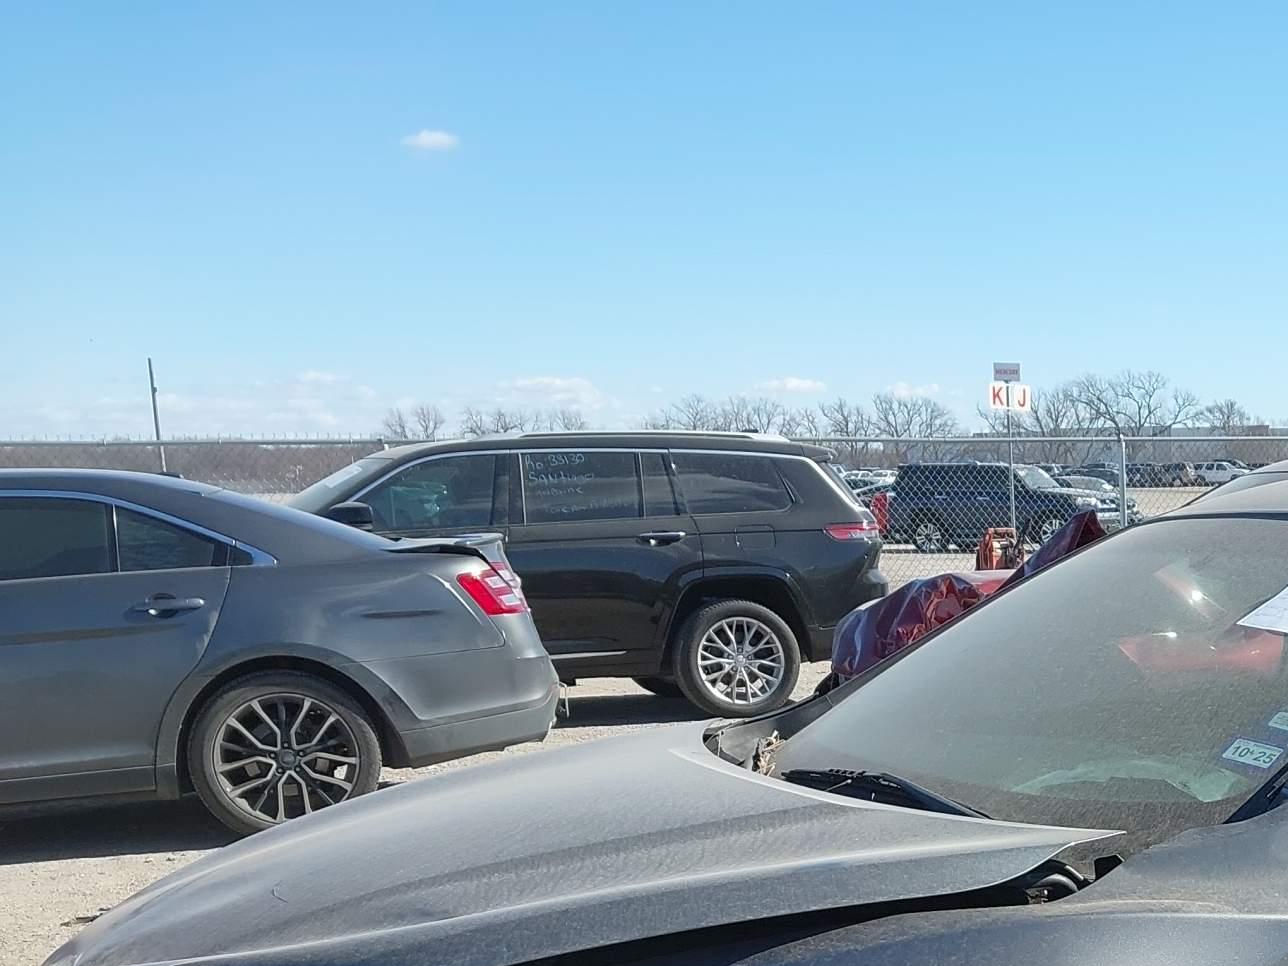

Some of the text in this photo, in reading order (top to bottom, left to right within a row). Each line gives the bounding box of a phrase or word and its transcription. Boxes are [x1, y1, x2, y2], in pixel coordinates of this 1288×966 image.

[992, 385, 1004, 406] K
[1017, 388, 1026, 408] J
[1231, 745, 1250, 758] 10
[1252, 751, 1277, 764] 25
